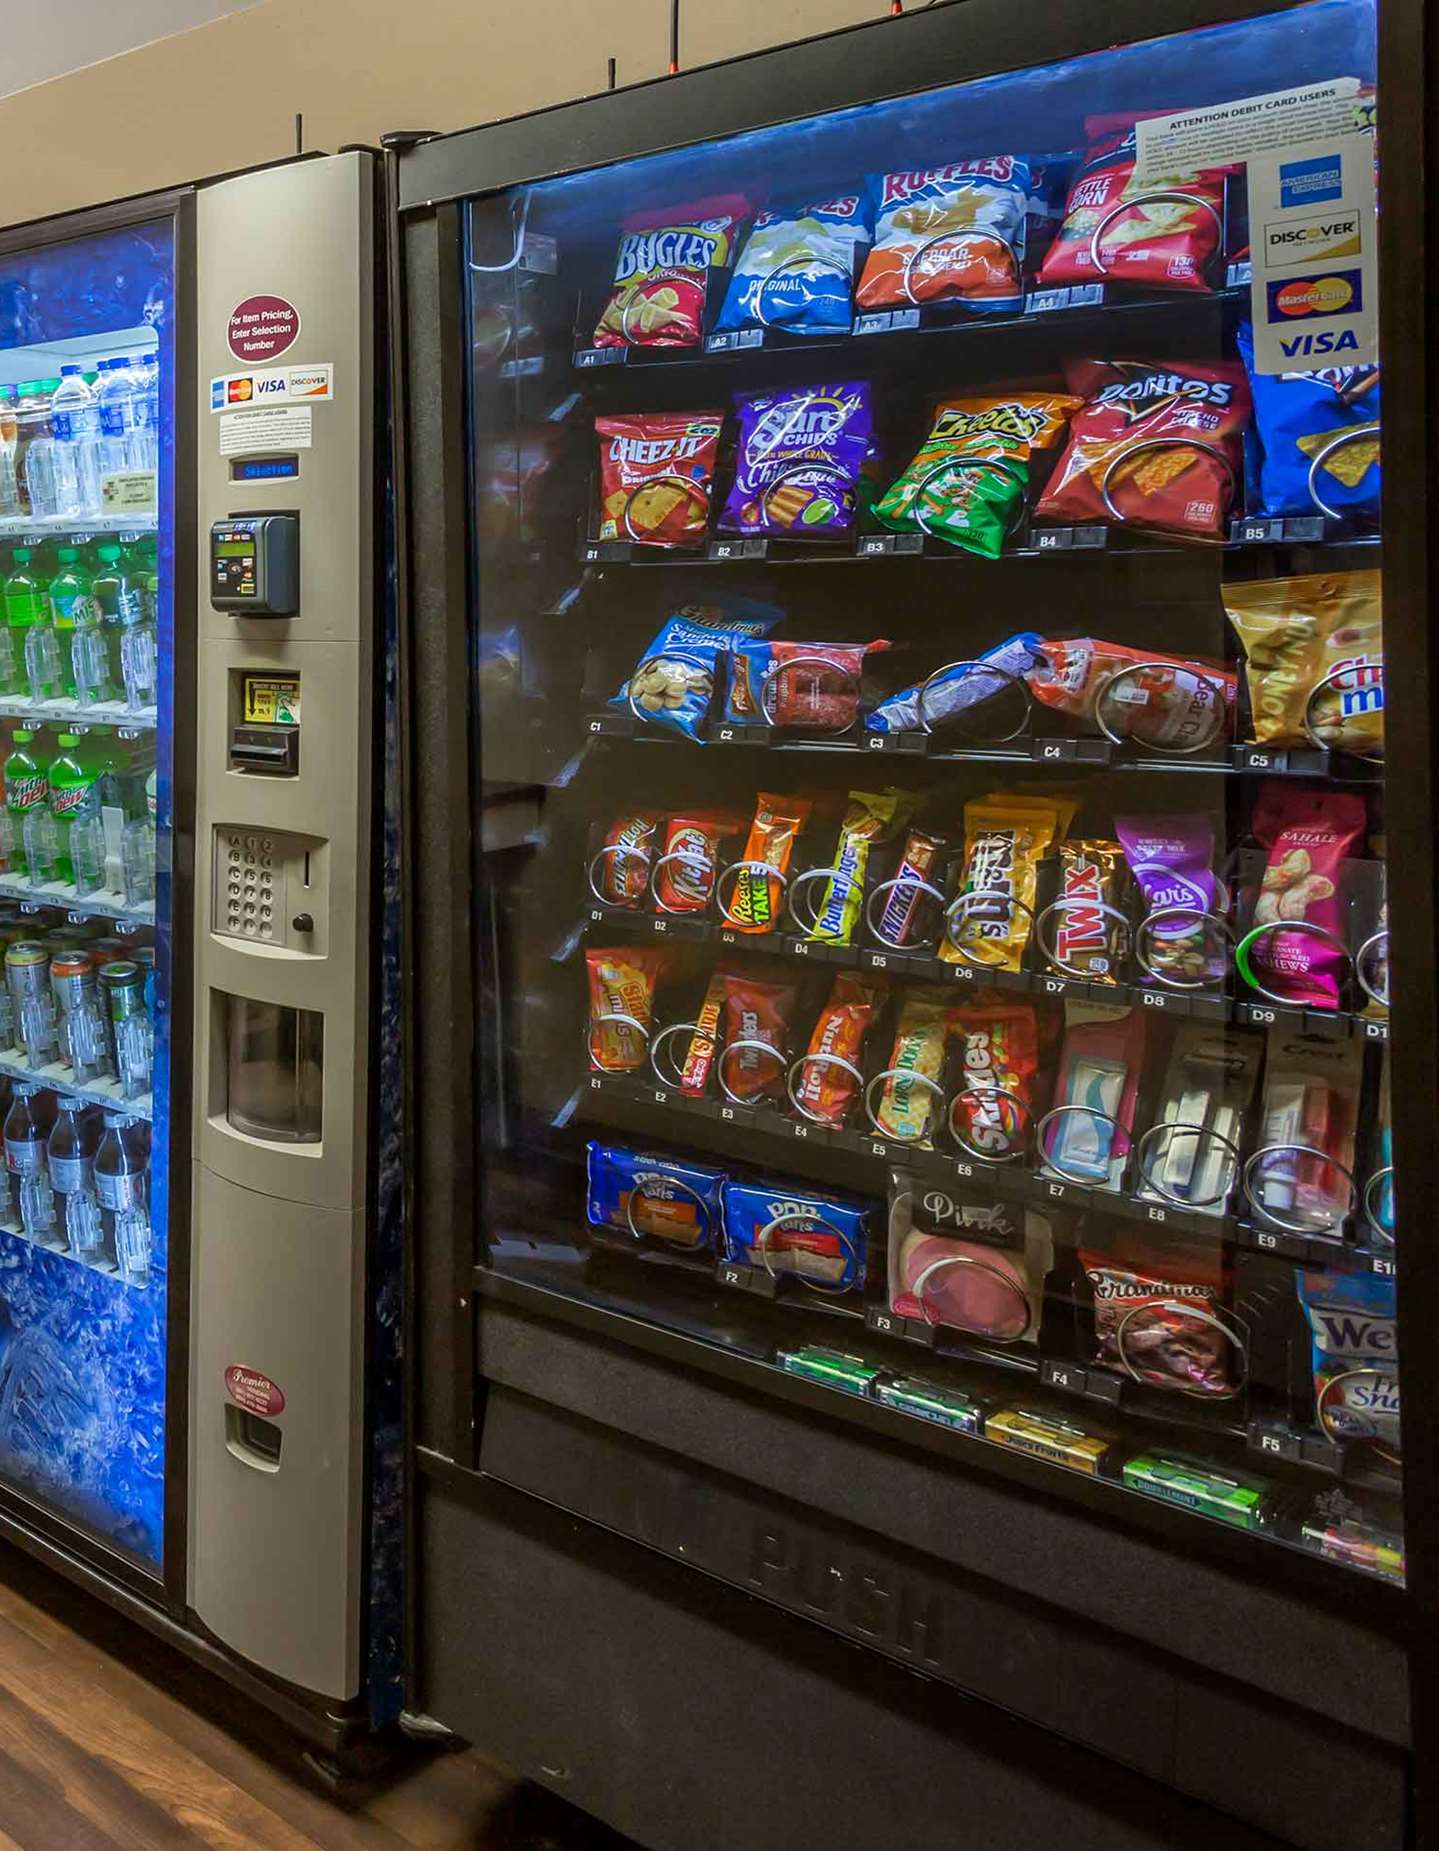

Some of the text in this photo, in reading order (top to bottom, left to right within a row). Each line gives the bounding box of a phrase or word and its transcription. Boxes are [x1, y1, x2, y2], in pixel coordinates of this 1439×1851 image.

[1169, 88, 1336, 131] ATTENTION DEBIT CARD USERS
[883, 155, 1015, 204] RUFFLES
[1280, 169, 1339, 188] AMERICAN
[1292, 179, 1340, 195] EXPRESS
[1270, 221, 1355, 245] DISCOVER
[614, 230, 716, 283] BUGLES
[749, 278, 802, 292] ORGINAL
[1278, 286, 1347, 306] MasterCard
[1038, 298, 1054, 308] A4
[231, 316, 241, 326] For
[242, 313, 260, 324] Item
[863, 320, 878, 332] A3
[232, 324, 291, 340] Enter Selection
[243, 340, 275, 352] Number
[715, 337, 727, 347] A2
[1280, 330, 1359, 357] VISA
[583, 355, 594, 365] A1
[257, 379, 286, 393] VISA
[290, 376, 325, 386] DISCOVER
[928, 402, 1048, 443] Cheetos
[783, 431, 838, 447] CHIPS
[610, 435, 702, 465] CHEEZ-IT
[244, 463, 295, 480] Selection
[1246, 528, 1264, 540] B5
[867, 542, 883, 553] B3
[1040, 535, 1056, 548] B4
[718, 547, 730, 557] B2
[590, 722, 601, 732] C1
[720, 730, 733, 740] C2
[870, 738, 884, 748] C3
[1044, 746, 1060, 758] C4
[1250, 754, 1269, 767] C5
[1280, 830, 1338, 844] SAHALE
[591, 911, 603, 921] D1
[1056, 865, 1107, 962] TWIX
[654, 921, 667, 931] D2
[795, 944, 808, 955] D4
[872, 956, 886, 968] D5
[956, 968, 973, 980] D6
[1046, 981, 1066, 993] D7
[1144, 994, 1165, 1007] D8
[1252, 1010, 1276, 1023] D9
[591, 1078, 602, 1089] E1
[655, 1091, 667, 1103] E2
[722, 1107, 734, 1120] E3
[795, 1125, 808, 1137] E4
[872, 1143, 887, 1156] E5
[957, 1163, 973, 1177] E6
[1049, 1184, 1065, 1197] E7
[1148, 1207, 1165, 1221] E8
[1258, 1233, 1276, 1248] E9
[725, 1272, 738, 1283] F2
[877, 1318, 891, 1330] F3
[1318, 1315, 1397, 1350] We
[1052, 1371, 1068, 1386] F4
[1261, 1435, 1281, 1451] F5
